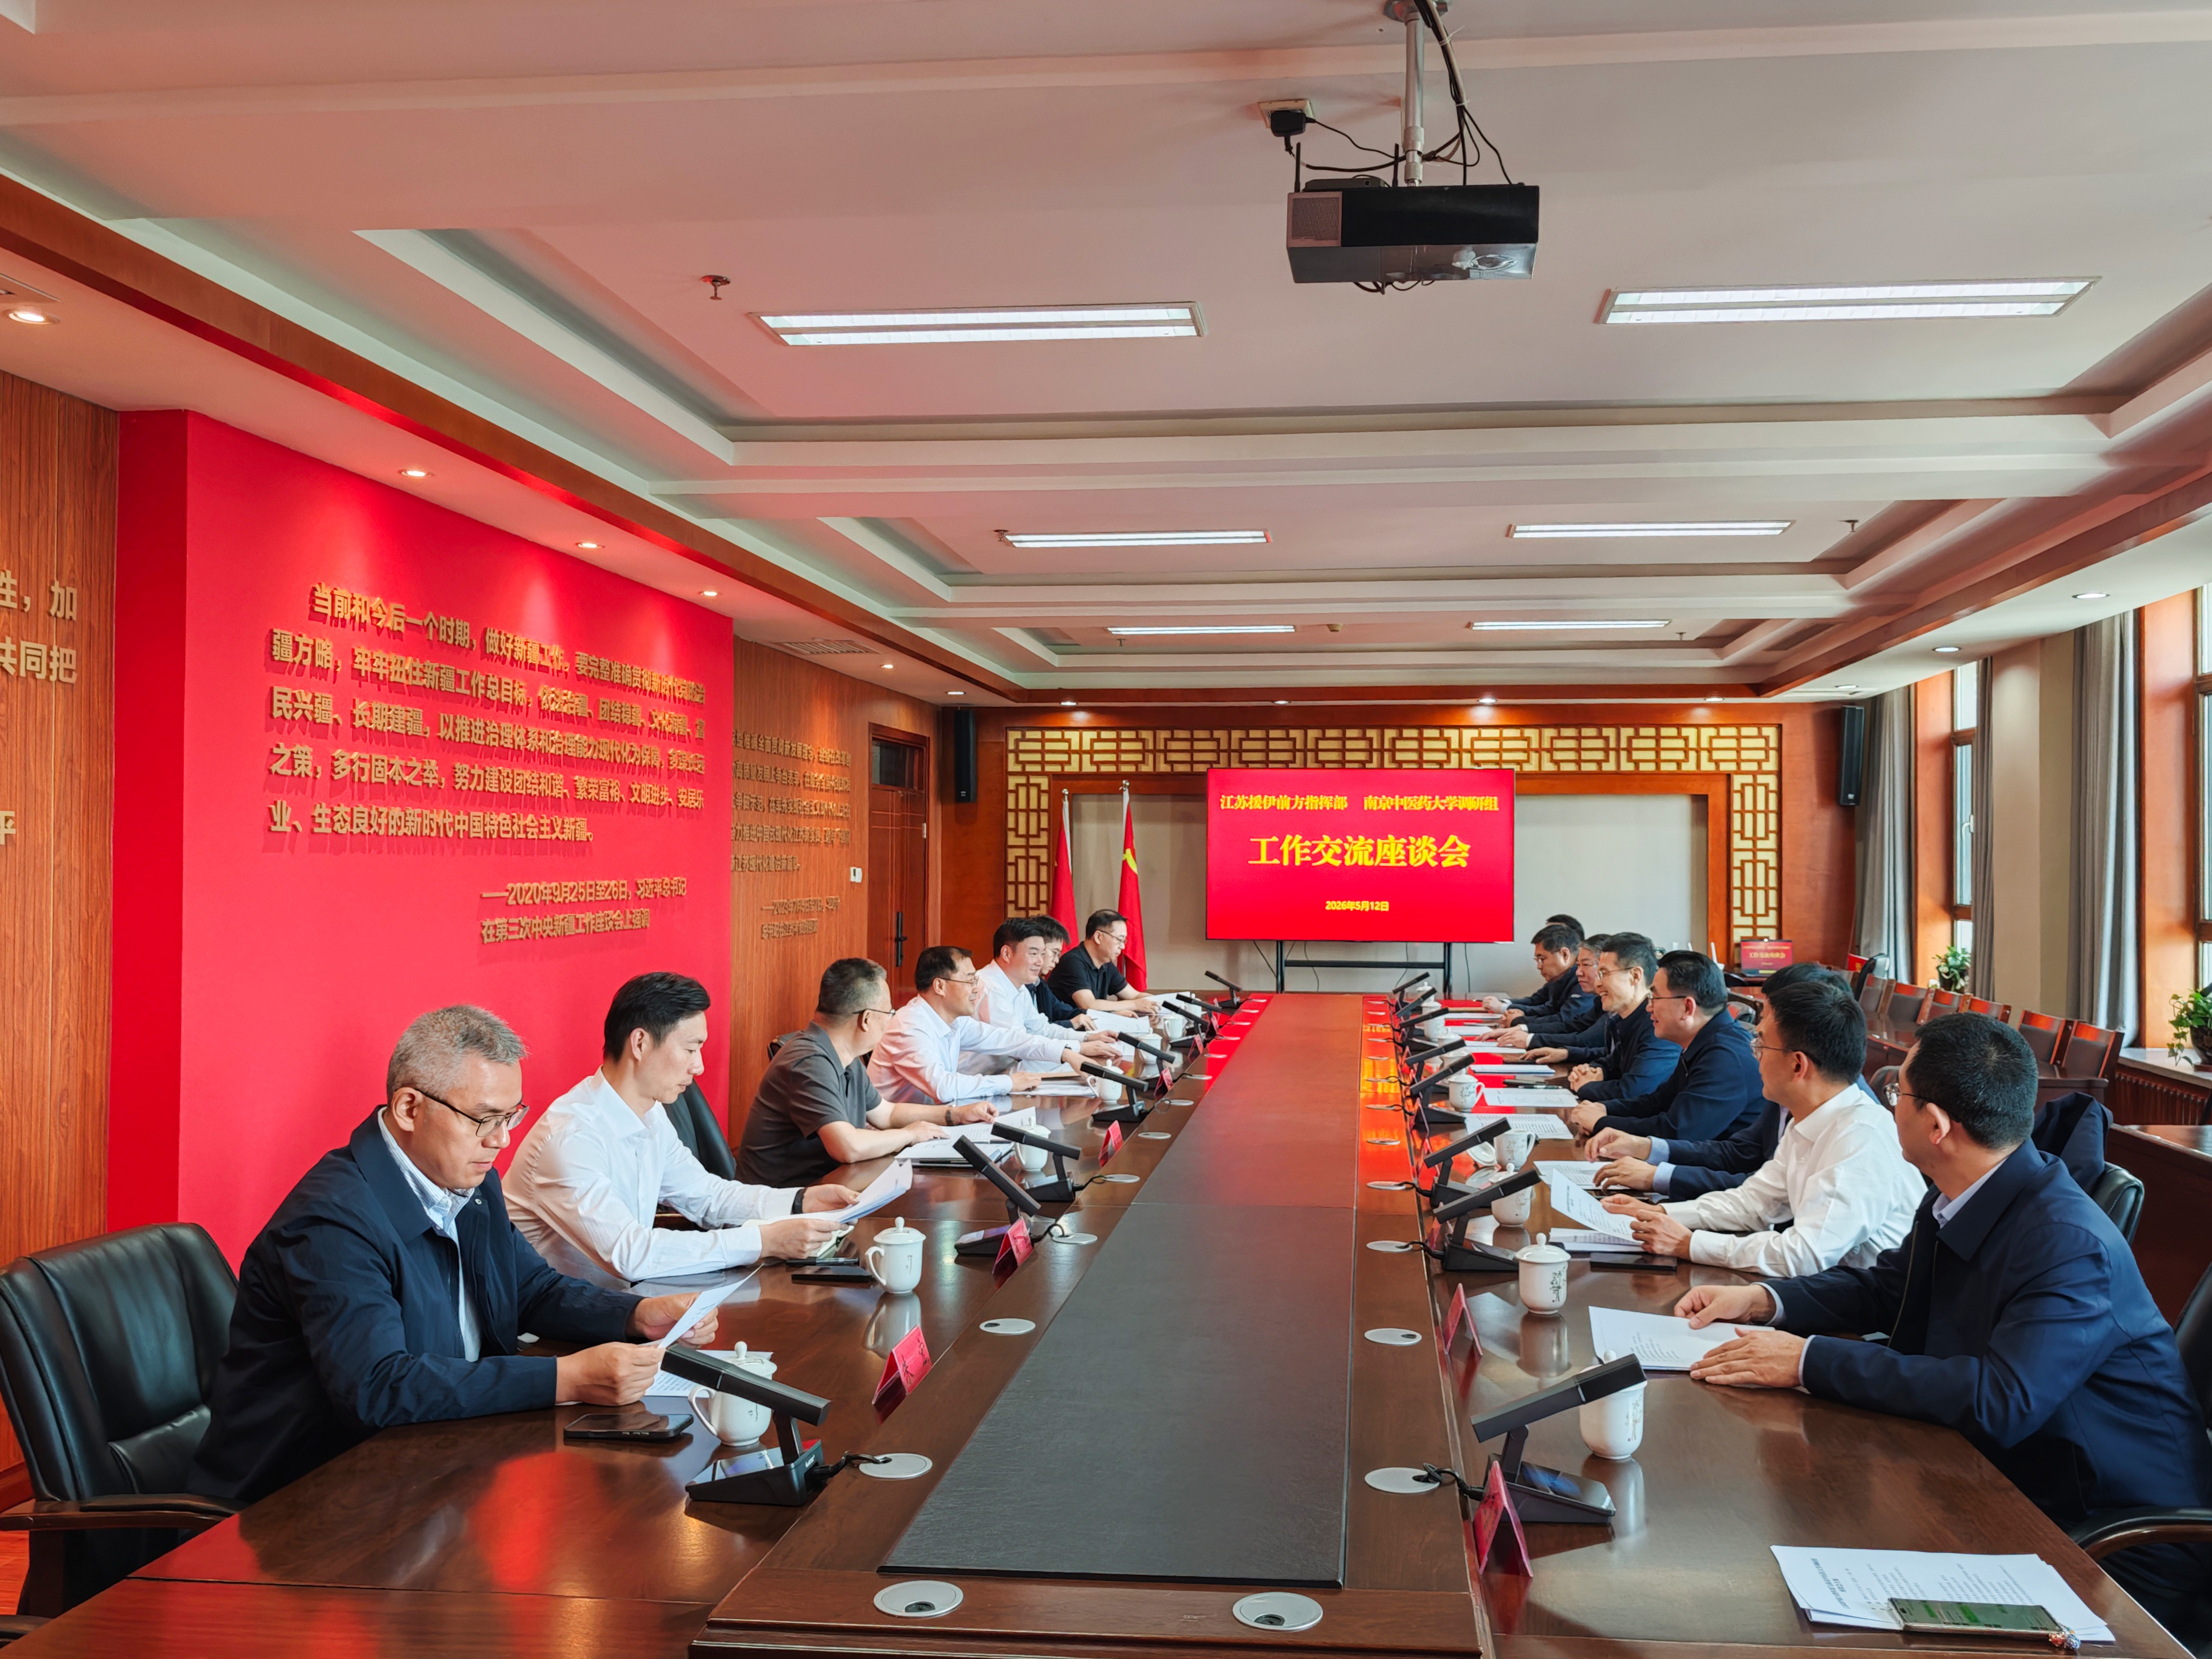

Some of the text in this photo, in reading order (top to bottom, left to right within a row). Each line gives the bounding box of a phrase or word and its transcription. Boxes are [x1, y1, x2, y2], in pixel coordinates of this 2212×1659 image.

[1220, 794, 1500, 811] 江苏援伊前方指挥部 南京中医药大学调研组
[1247, 834, 1472, 868] 工作交流座谈会
[1325, 900, 1390, 912] 2026年5月12日
[481, 908, 650, 944] 在第三次中央新疆工作座谈会上强调
